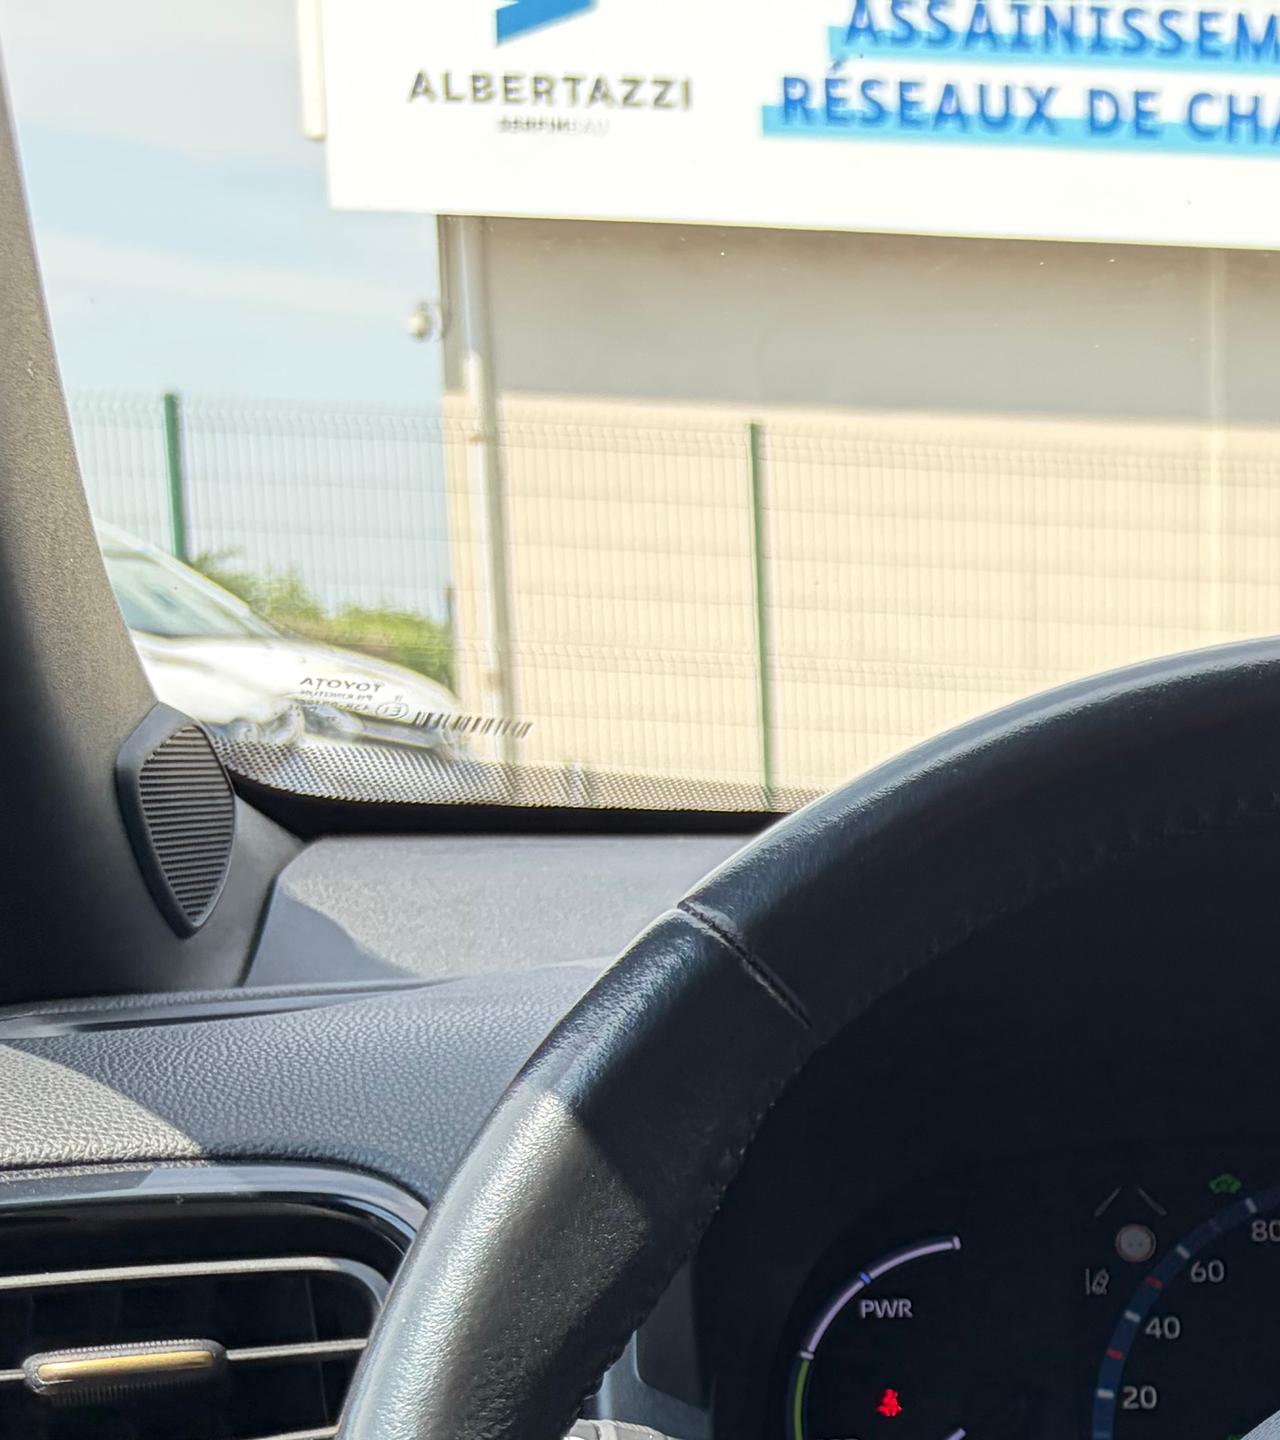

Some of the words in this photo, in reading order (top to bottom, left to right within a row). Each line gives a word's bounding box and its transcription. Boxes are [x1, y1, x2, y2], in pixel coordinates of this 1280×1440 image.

[408, 68, 692, 112] ALBERTAZZI
[779, 60, 1060, 138] RÉSEAUX
[1087, 89, 1157, 141] DE
[1190, 1260, 1225, 1283] 60
[860, 1298, 913, 1319] PWR
[1145, 1317, 1181, 1340] 40
[1122, 1386, 1157, 1409] 20
